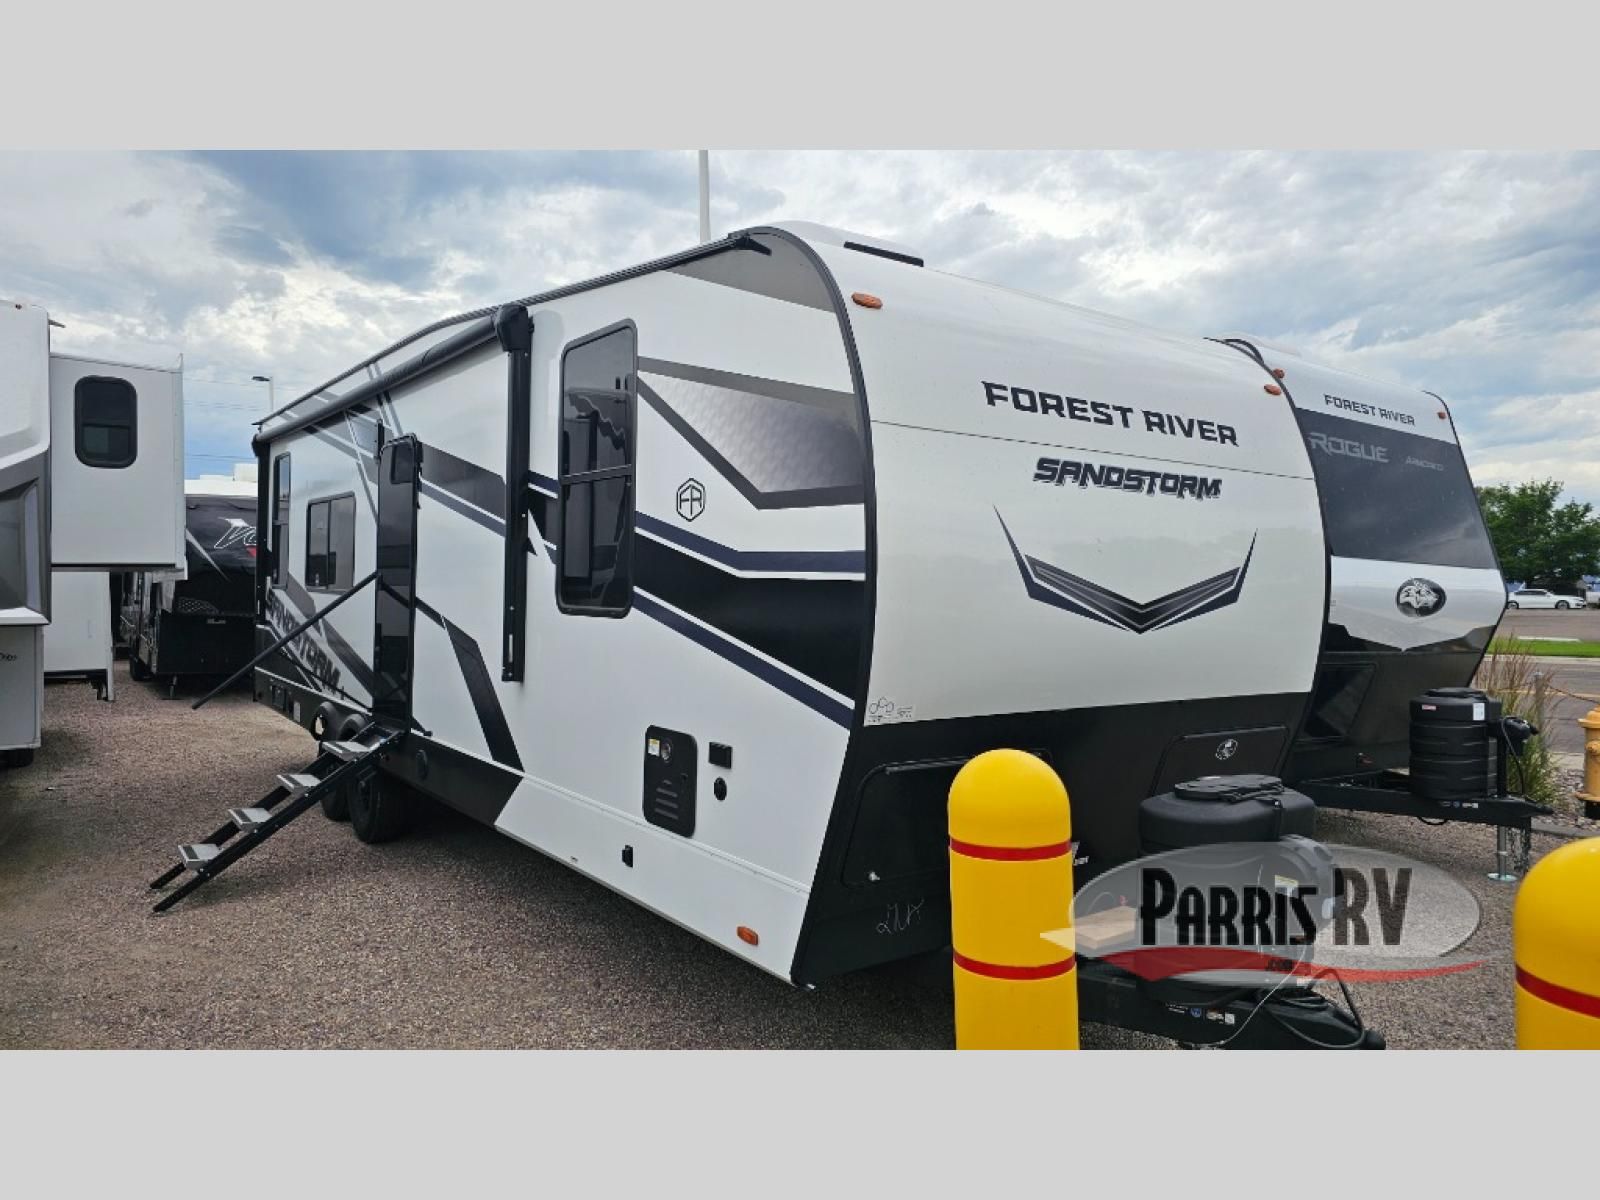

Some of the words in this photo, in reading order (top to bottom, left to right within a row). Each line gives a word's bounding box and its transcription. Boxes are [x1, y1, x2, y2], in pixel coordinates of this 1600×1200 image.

[981, 381, 1133, 428] FOREST
[1141, 409, 1239, 447] RIVER
[1324, 393, 1376, 416] FOREST
[1378, 407, 1416, 426] RIVER
[1308, 432, 1390, 463] ROGUE
[1033, 457, 1223, 500] SANDSTORM
